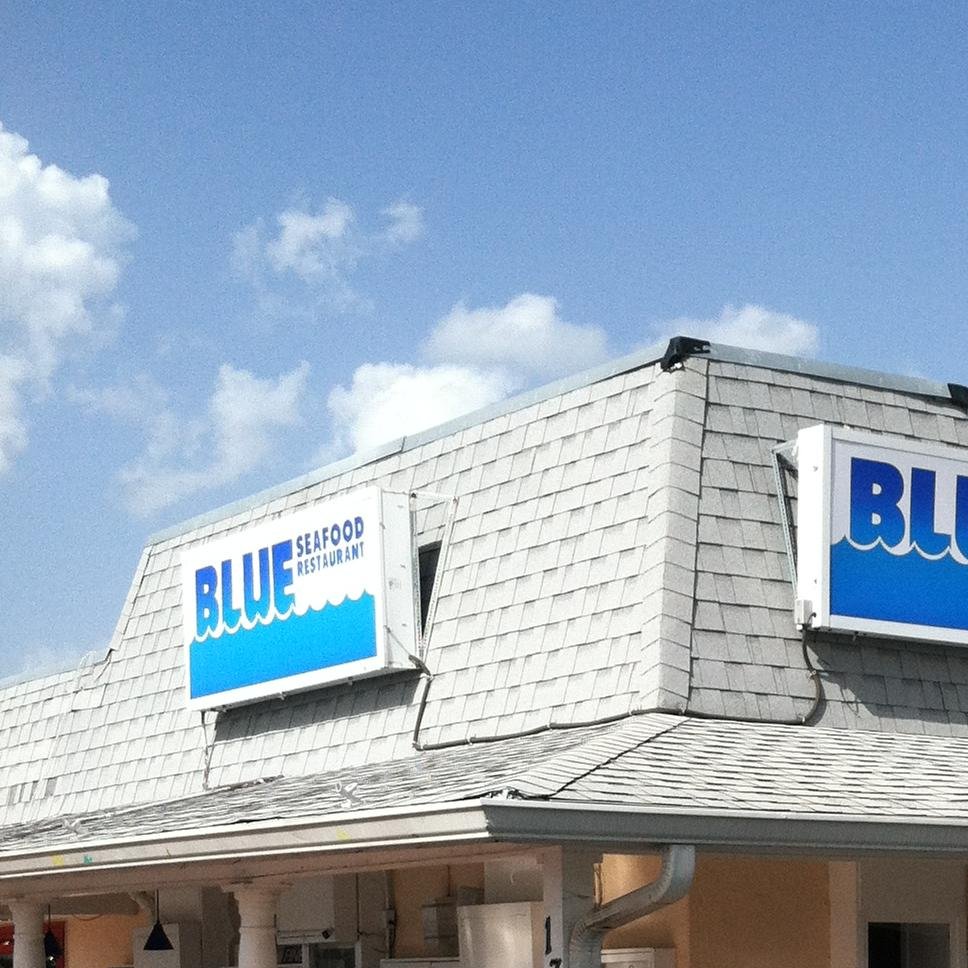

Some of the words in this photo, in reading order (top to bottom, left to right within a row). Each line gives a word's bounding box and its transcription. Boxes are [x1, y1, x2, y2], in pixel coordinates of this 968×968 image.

[296, 516, 364, 558] SEAFOOD
[296, 542, 364, 576] RESTAURANT
[195, 539, 296, 635] BLUE
